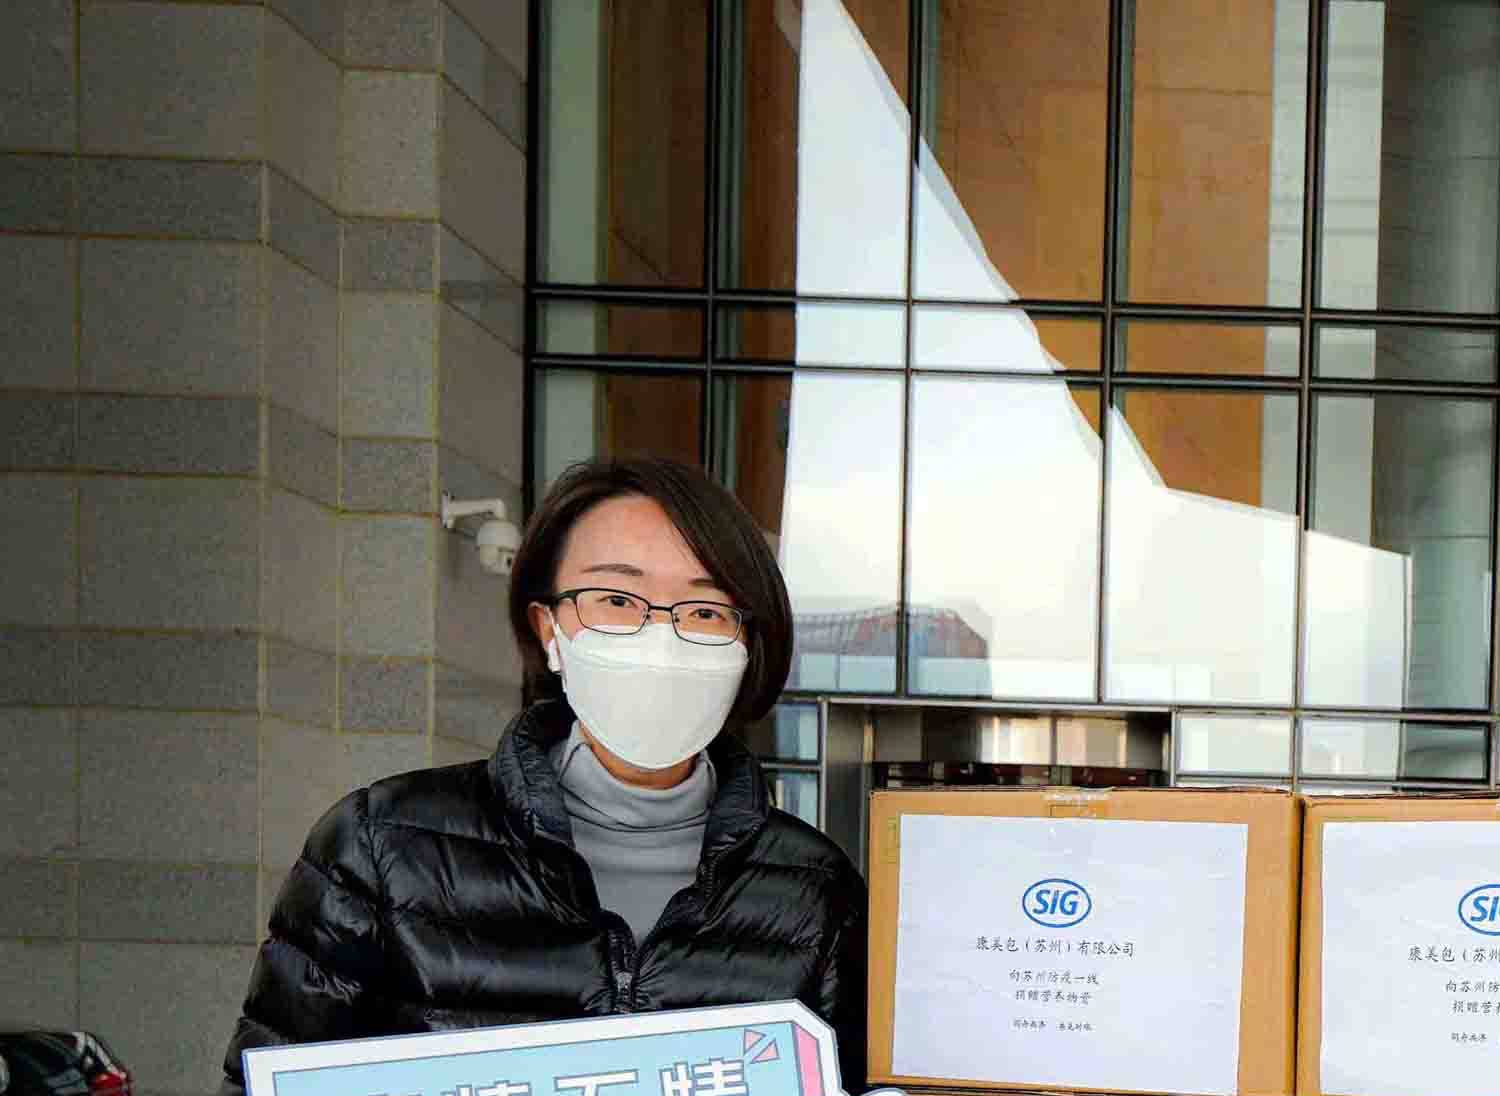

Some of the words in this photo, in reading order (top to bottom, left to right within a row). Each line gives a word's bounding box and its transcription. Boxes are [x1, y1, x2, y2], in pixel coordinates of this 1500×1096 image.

[1032, 889, 1079, 916] SIG
[975, 935, 1134, 958] 康美包（苏州）有限公司
[1008, 969, 1099, 985] 向苏州防疫一线
